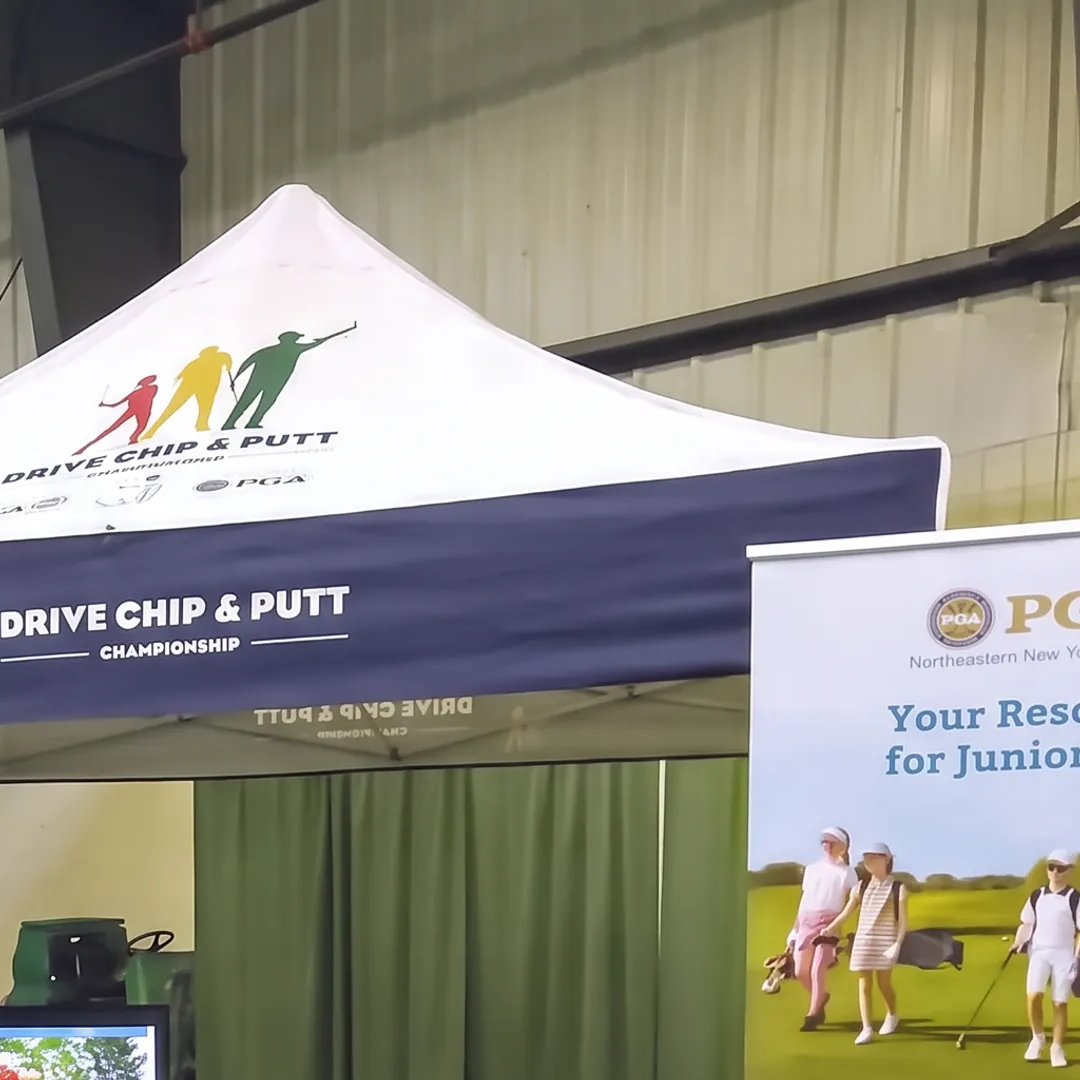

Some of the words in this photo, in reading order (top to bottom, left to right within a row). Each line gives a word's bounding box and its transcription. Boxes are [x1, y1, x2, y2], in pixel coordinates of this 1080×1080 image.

[1, 455, 107, 485] DRIVE
[114, 441, 198, 463] CHIP
[207, 437, 234, 451] &
[240, 431, 338, 449] PUTT
[0, 603, 107, 639] DRIVE
[115, 597, 206, 630] CHIP
[214, 594, 241, 623] &
[251, 585, 350, 621] PUTT
[100, 637, 240, 661] CHAMPIONSHIP
[910, 651, 1017, 669] Northeastern
[1023, 648, 1060, 663] New
[887, 704, 986, 733] Your
[886, 745, 945, 775] for
